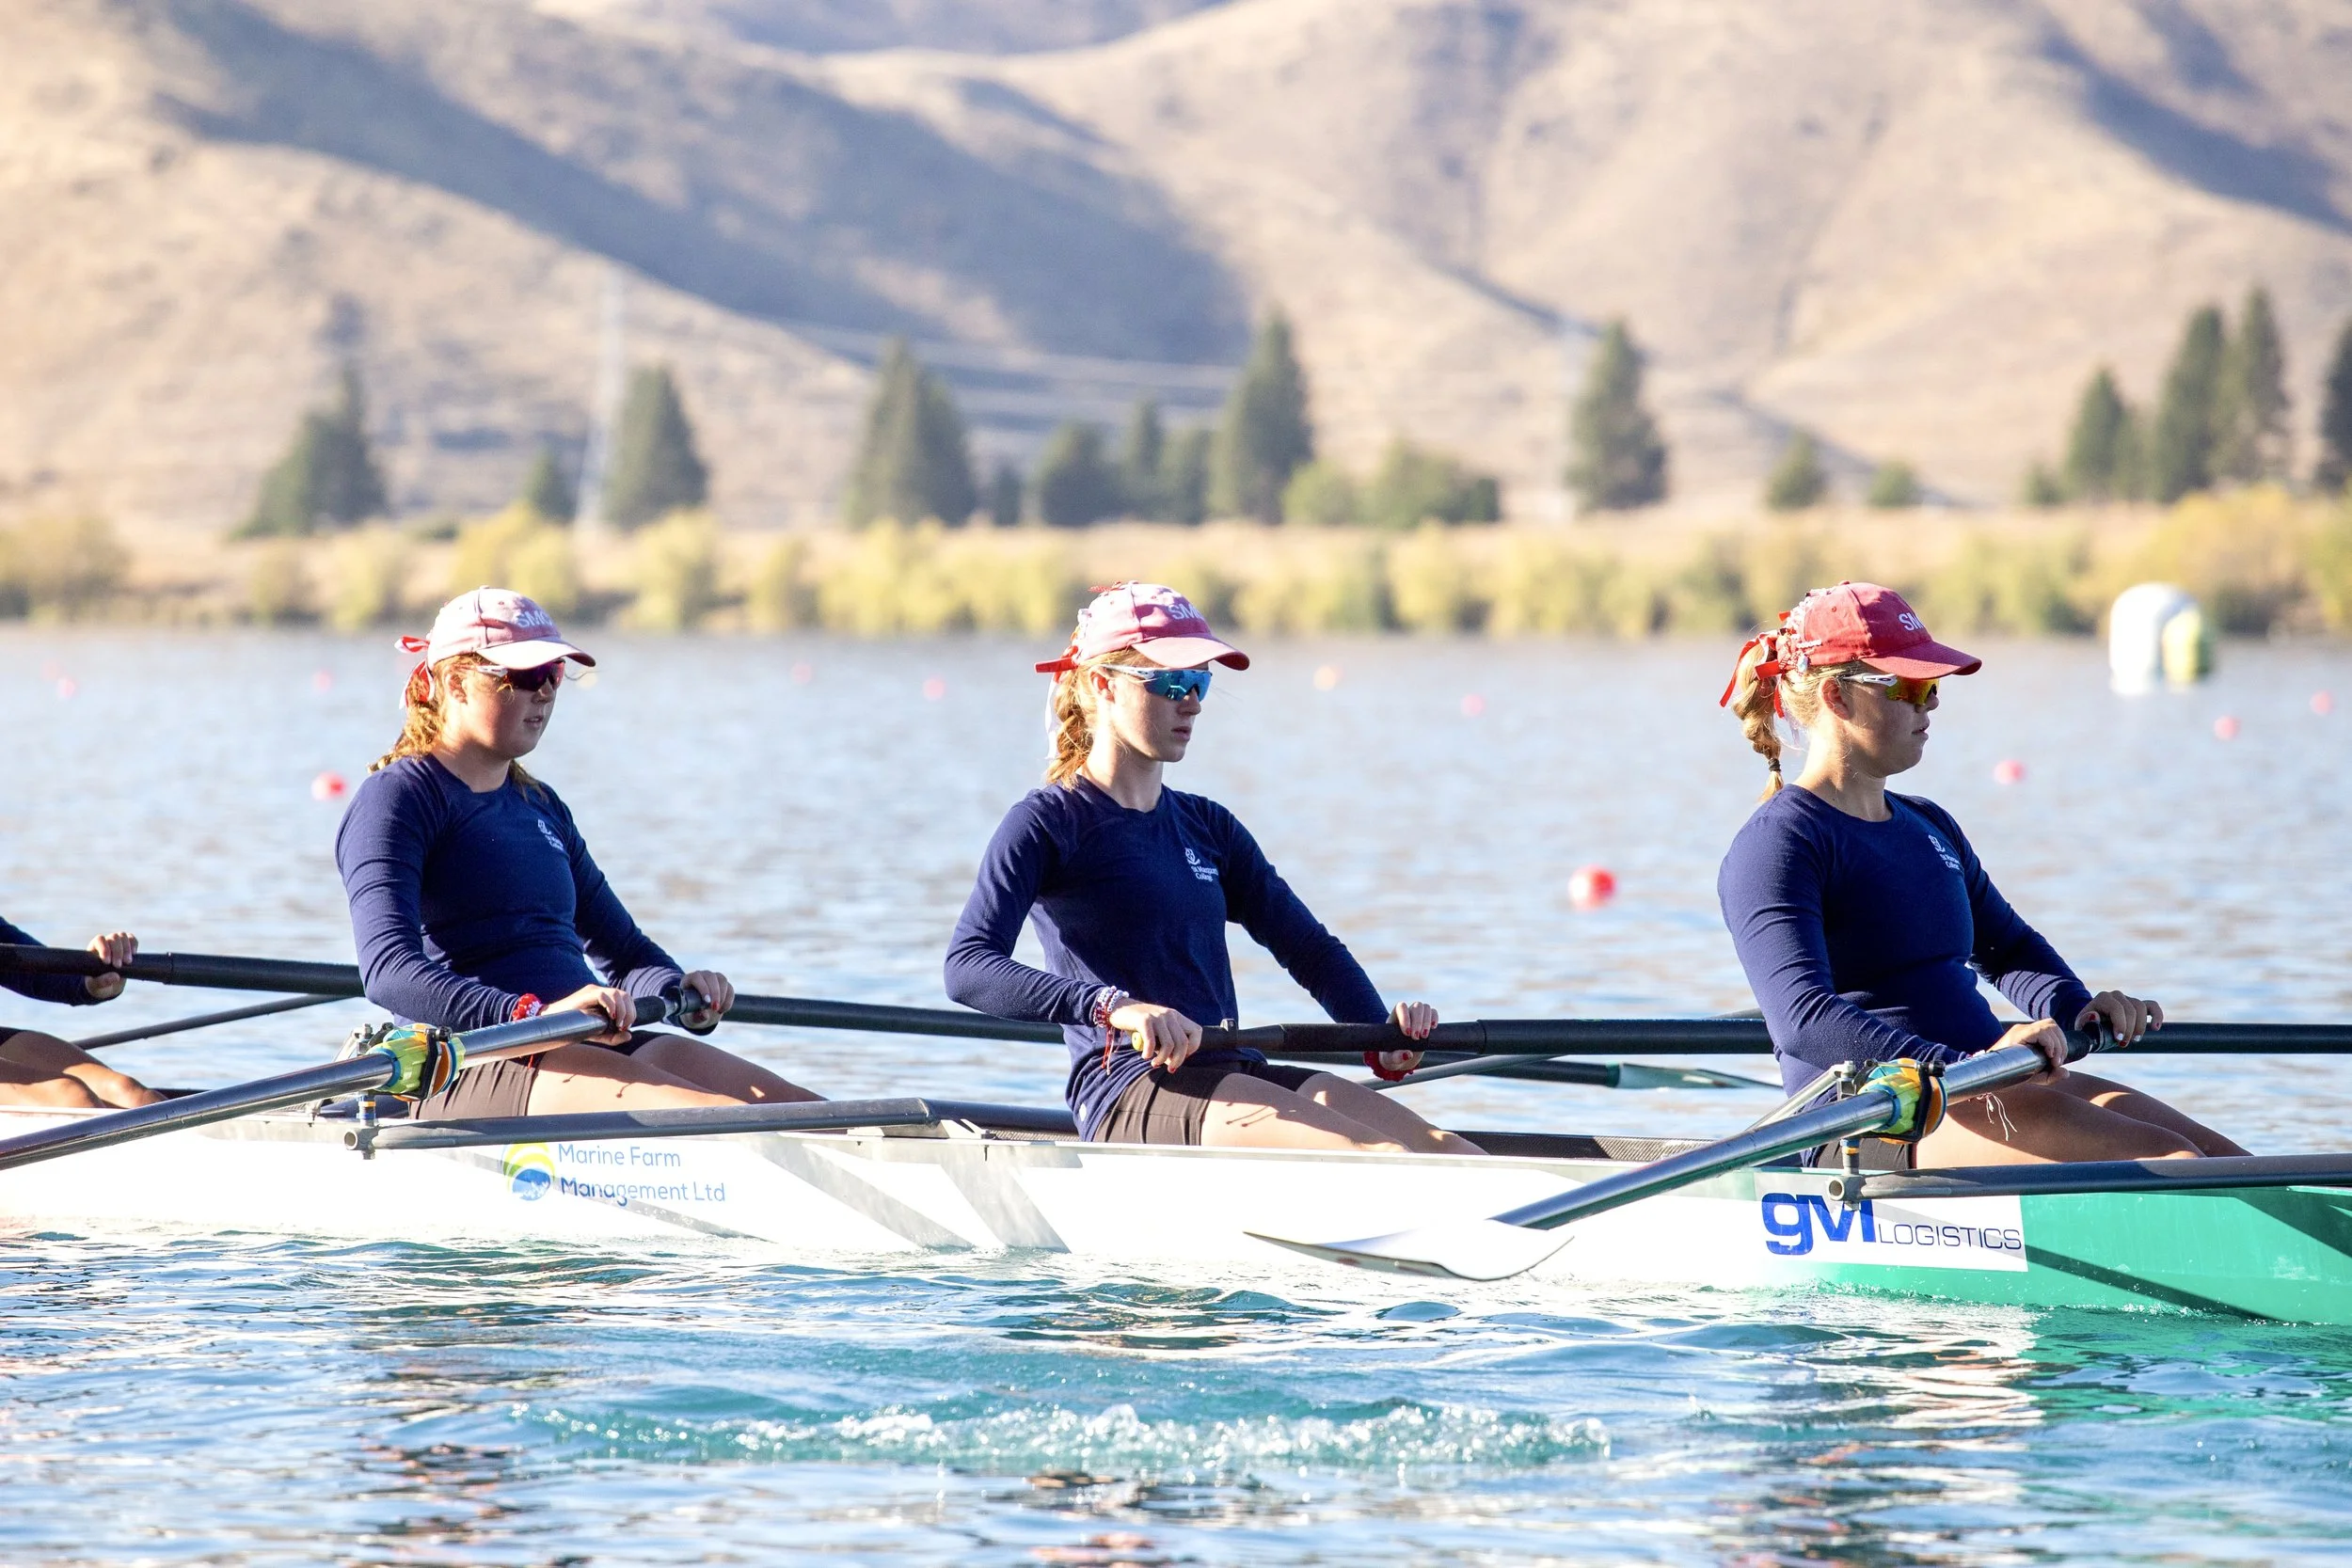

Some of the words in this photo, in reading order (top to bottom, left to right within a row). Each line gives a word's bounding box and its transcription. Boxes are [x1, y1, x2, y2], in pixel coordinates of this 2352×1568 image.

[558, 1143, 625, 1165] Marine
[629, 1146, 681, 1167] Farm
[560, 1177, 689, 1206] Management
[693, 1181, 725, 1202] Ltd
[1878, 1223, 2022, 1250] LOGISTICS
